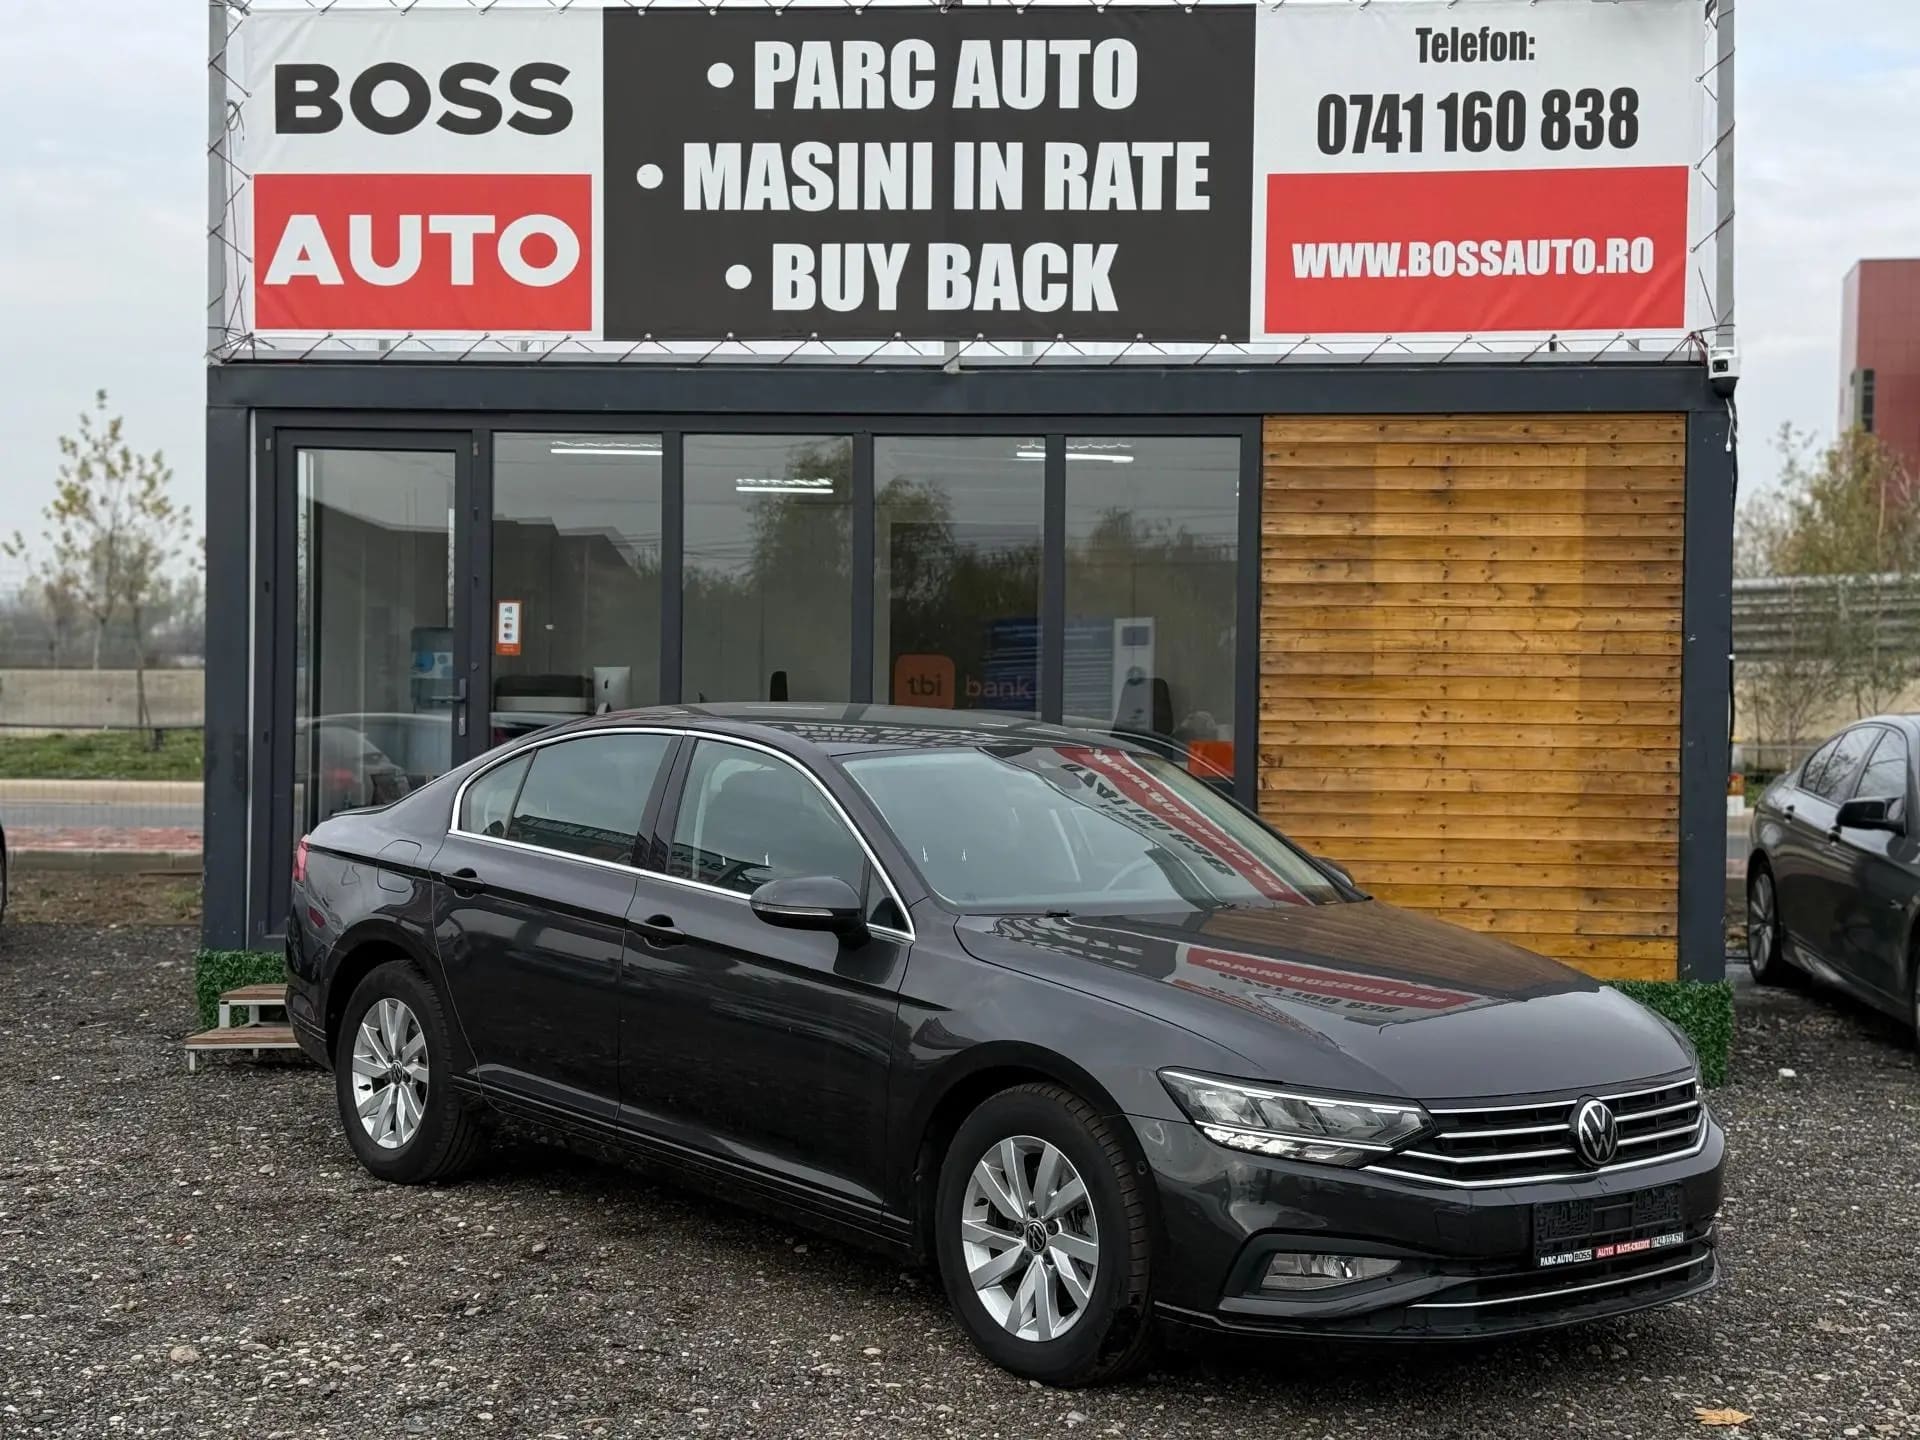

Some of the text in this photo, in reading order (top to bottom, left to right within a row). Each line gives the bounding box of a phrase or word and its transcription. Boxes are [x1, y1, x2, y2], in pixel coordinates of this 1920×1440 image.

[754, 37, 1138, 110] PARC AUTO
[1415, 27, 1536, 63] Telefon:
[274, 62, 574, 136] BOSS
[1317, 87, 1639, 156] 0741 160 838
[683, 141, 1210, 212] MASINI IN RATE
[263, 213, 581, 288] AUTO
[772, 242, 1119, 313] BUY BACK
[1291, 236, 1654, 279] WWW.BOSSAUTO.RO
[907, 664, 1031, 699] tbi bank
[1540, 1255, 1557, 1266] PARC
[1556, 1252, 1574, 1265] AUTO
[1574, 1250, 1591, 1261] BOSS
